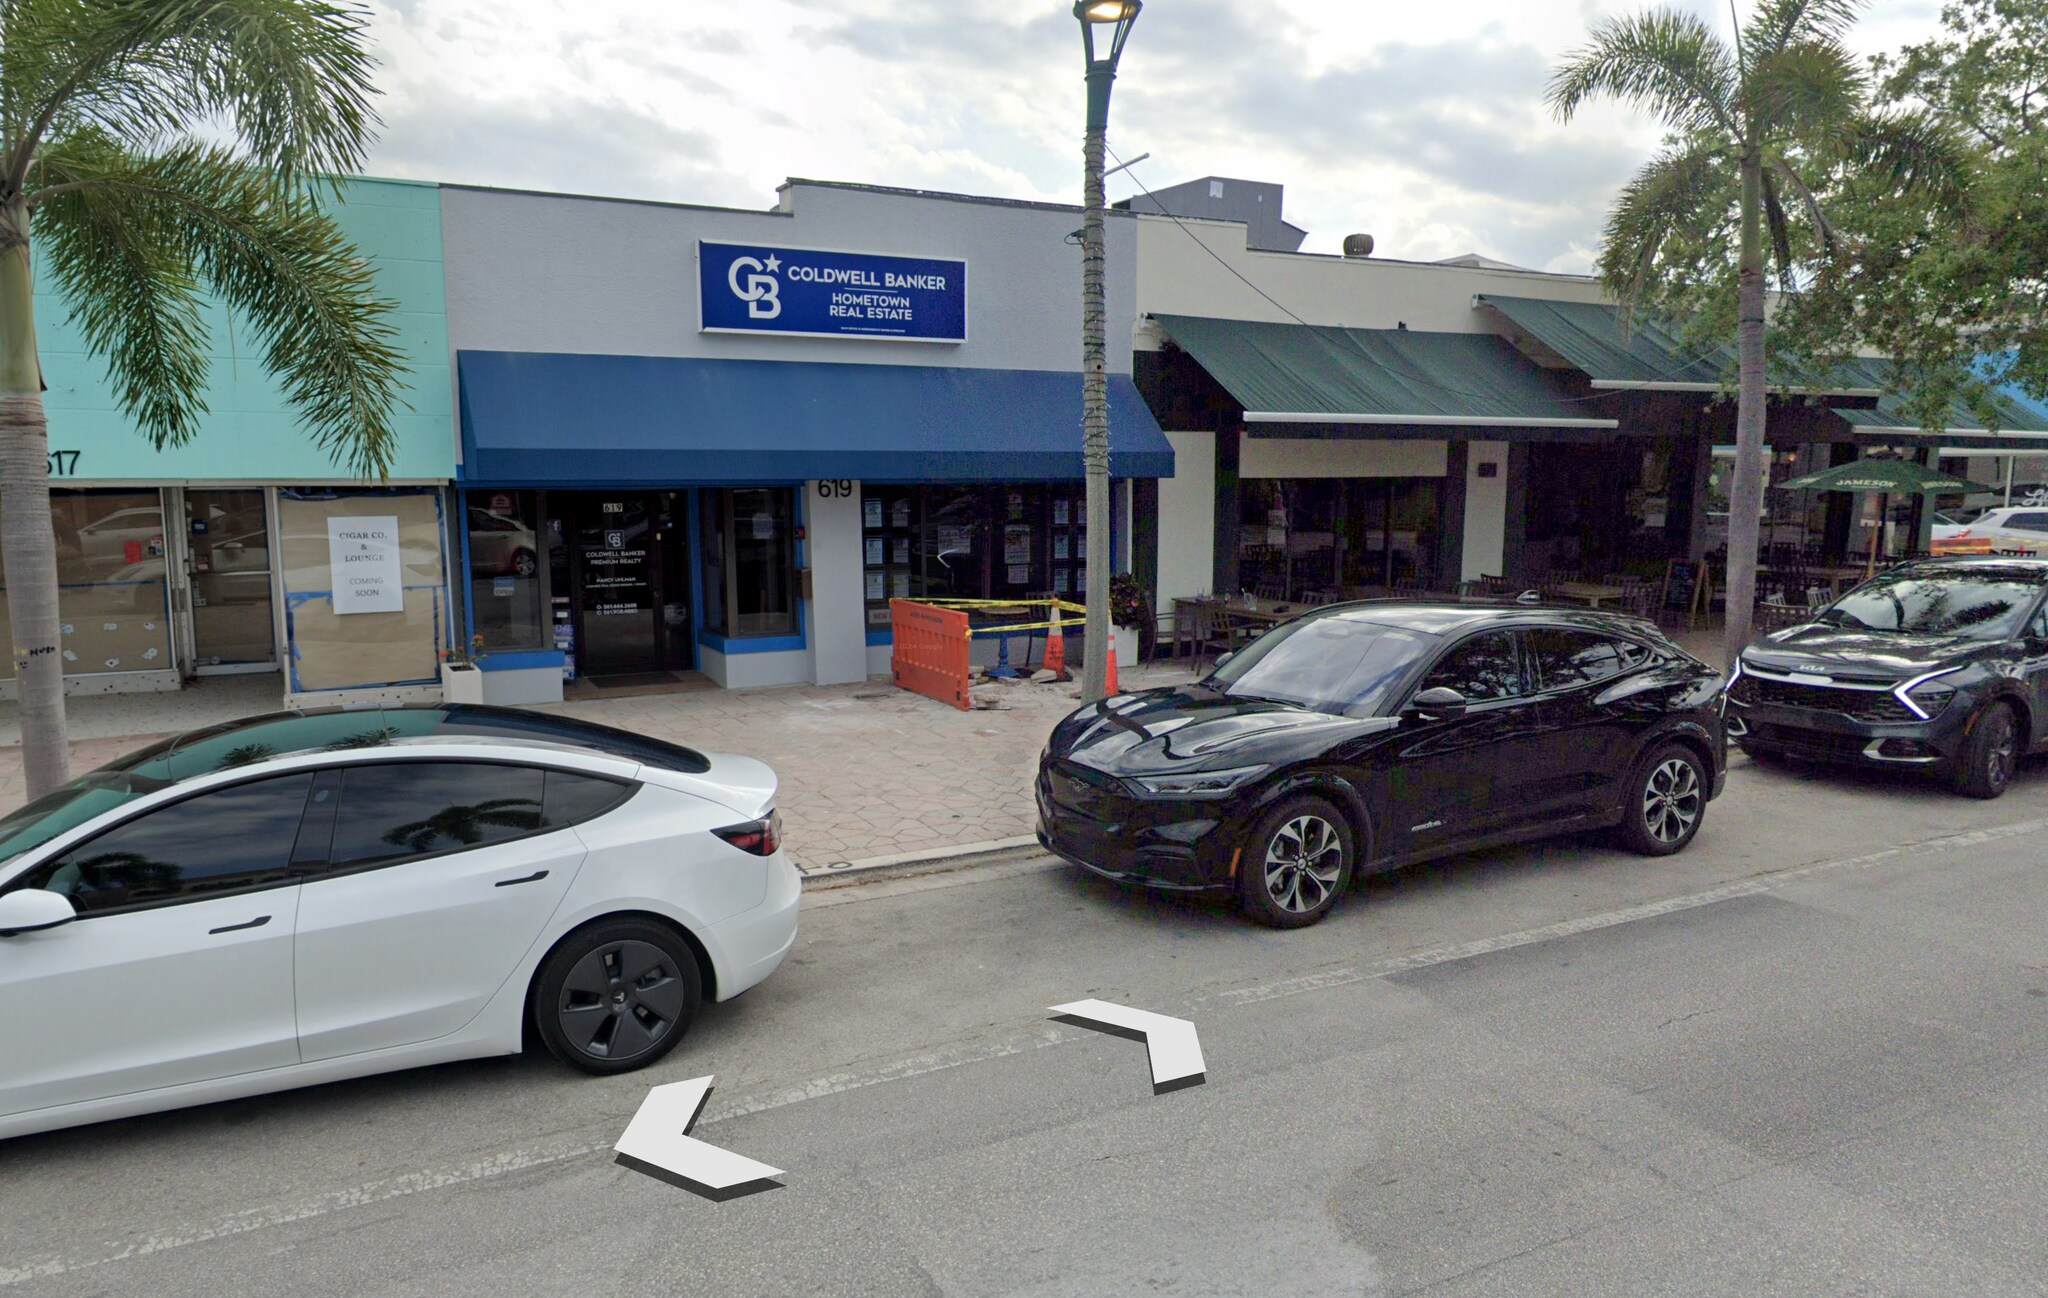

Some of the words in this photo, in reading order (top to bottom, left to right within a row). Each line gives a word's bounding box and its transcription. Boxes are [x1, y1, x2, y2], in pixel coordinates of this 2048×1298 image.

[788, 265, 881, 287] COLDWELL
[885, 272, 946, 291] BANKER
[832, 292, 910, 308] HOMETOWN
[829, 305, 864, 318] REAL
[867, 307, 913, 321] ESTATE
[1836, 478, 1897, 488] JAMESON
[818, 479, 852, 498] 619
[604, 503, 622, 512] 619
[339, 531, 369, 540] CIGAR
[371, 531, 388, 540] CO.
[360, 543, 368, 551] &
[345, 554, 384, 563] LOUNGE
[619, 557, 642, 565] REALTY
[349, 577, 384, 586] COMING
[354, 588, 380, 597] SOON
